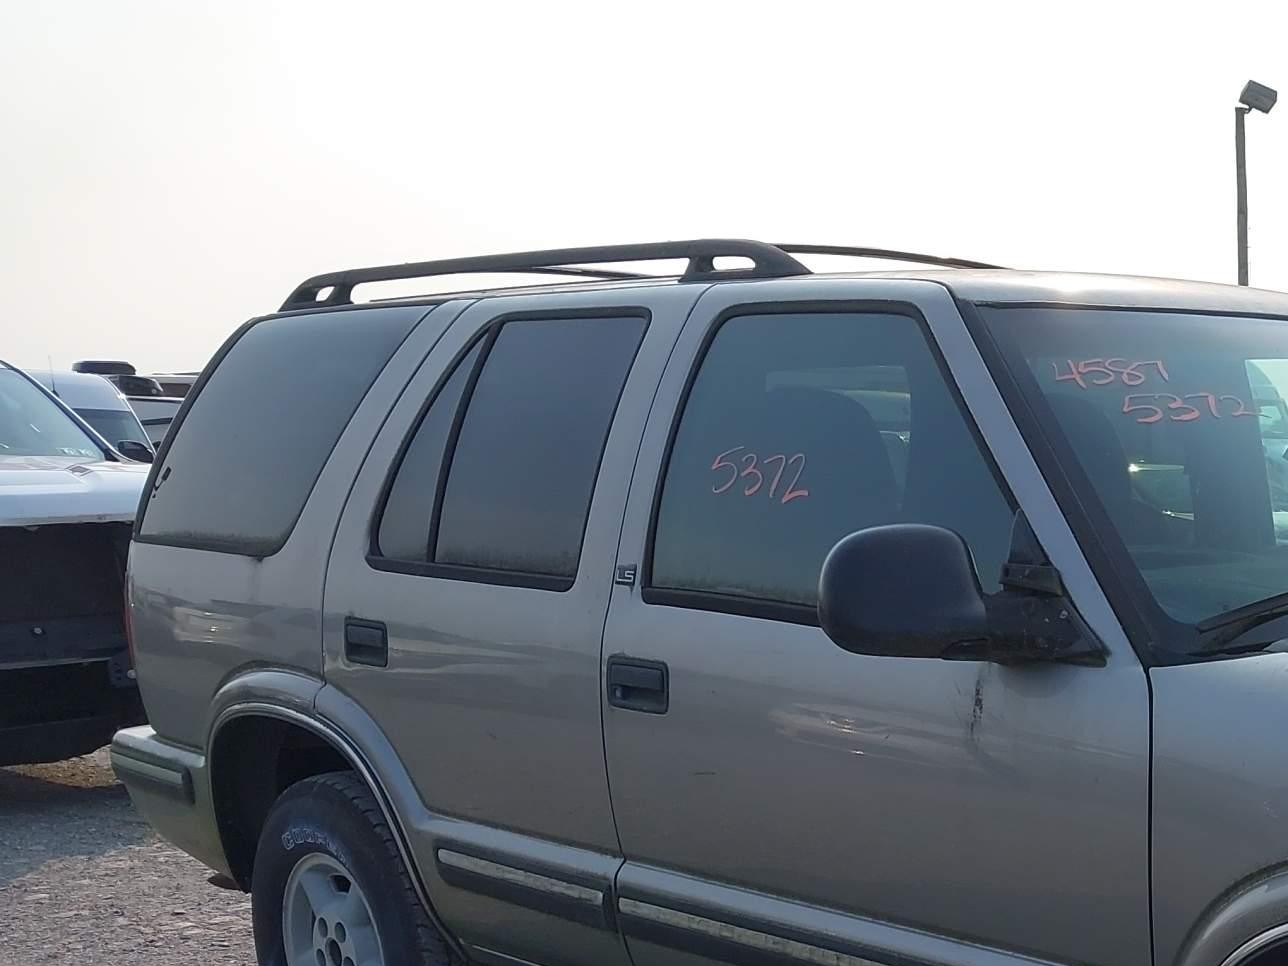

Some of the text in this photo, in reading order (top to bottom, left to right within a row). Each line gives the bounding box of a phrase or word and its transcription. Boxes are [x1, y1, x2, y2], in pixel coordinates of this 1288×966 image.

[1052, 358, 1169, 389] 4587
[1122, 392, 1272, 424] 5372
[711, 446, 809, 503] 5372
